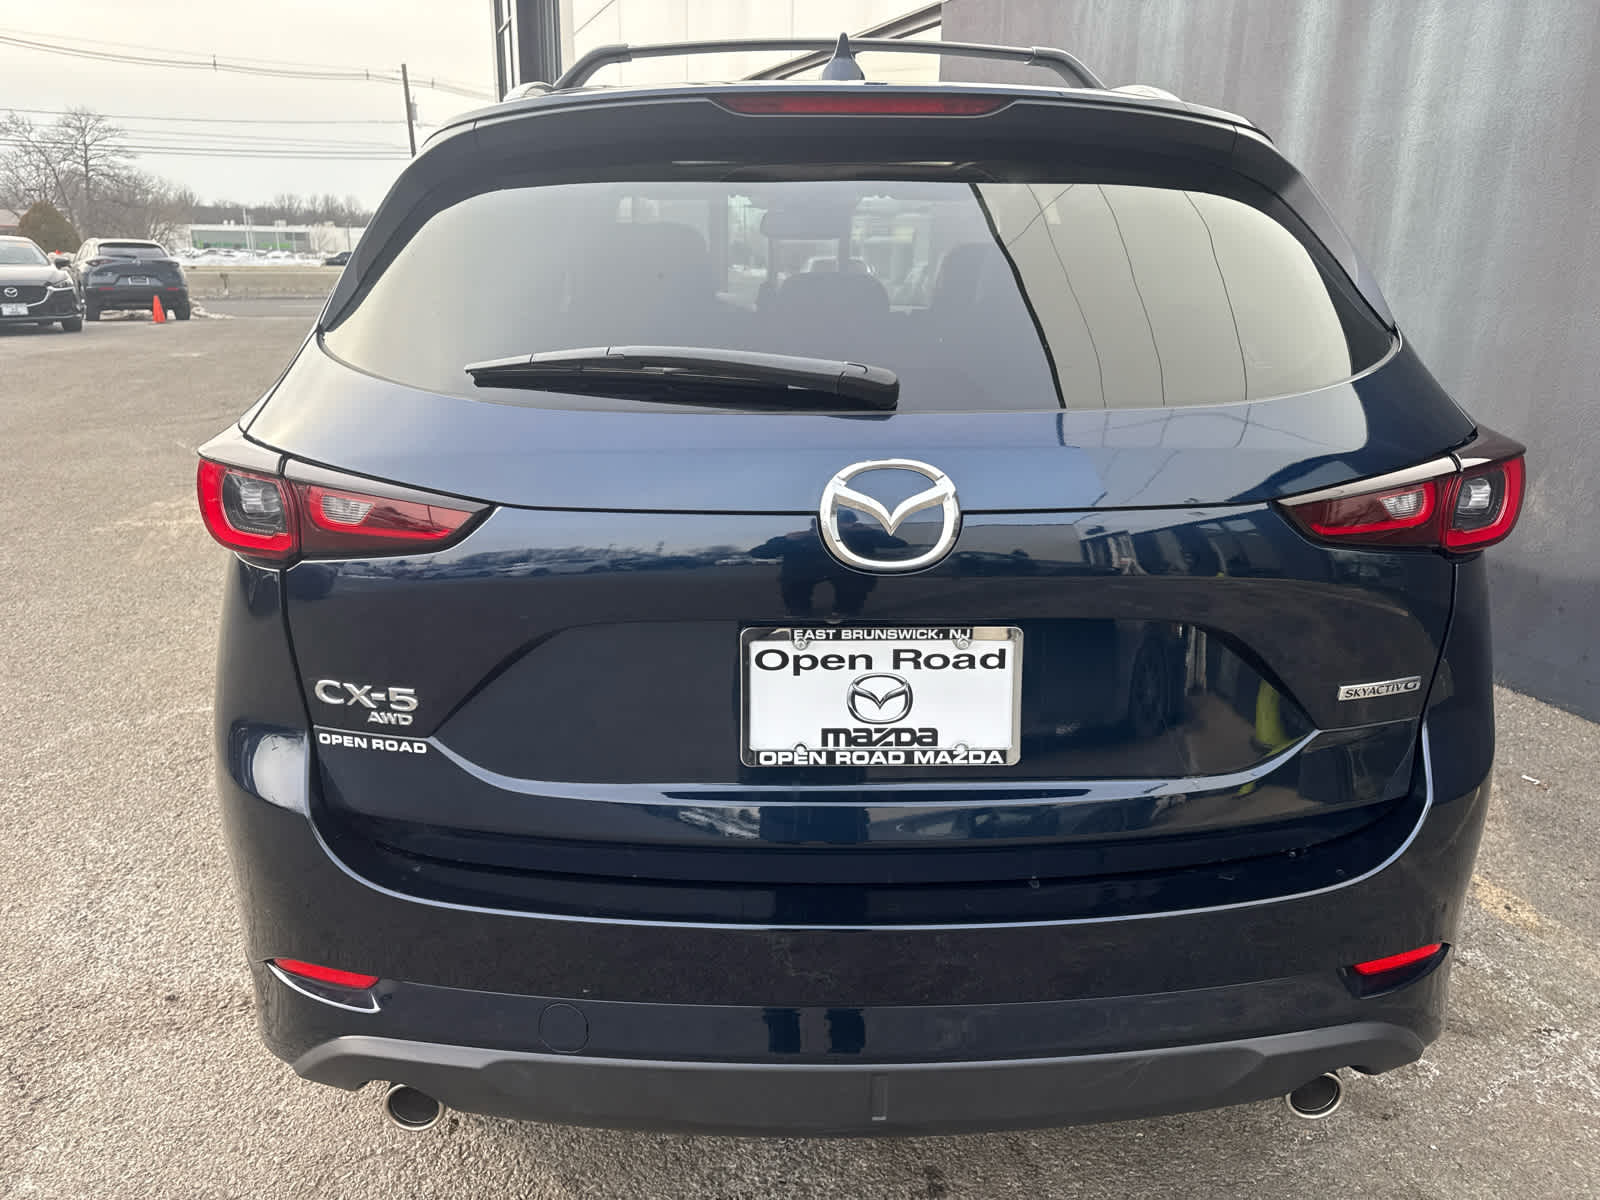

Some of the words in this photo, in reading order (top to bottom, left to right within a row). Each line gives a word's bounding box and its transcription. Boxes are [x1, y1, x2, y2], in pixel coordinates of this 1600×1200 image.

[793, 628, 836, 640] EAST
[841, 628, 944, 640] BRUNSWICK,
[950, 628, 971, 640] NJ
[754, 648, 873, 677] Open
[892, 648, 1007, 670] Road
[314, 679, 419, 712] CX-5
[367, 711, 414, 726] AWD
[319, 733, 368, 749] OPEN
[371, 738, 427, 754] ROAD
[758, 751, 827, 765] OPEN
[835, 751, 905, 765] ROAD
[914, 750, 1004, 765] MAZDA
